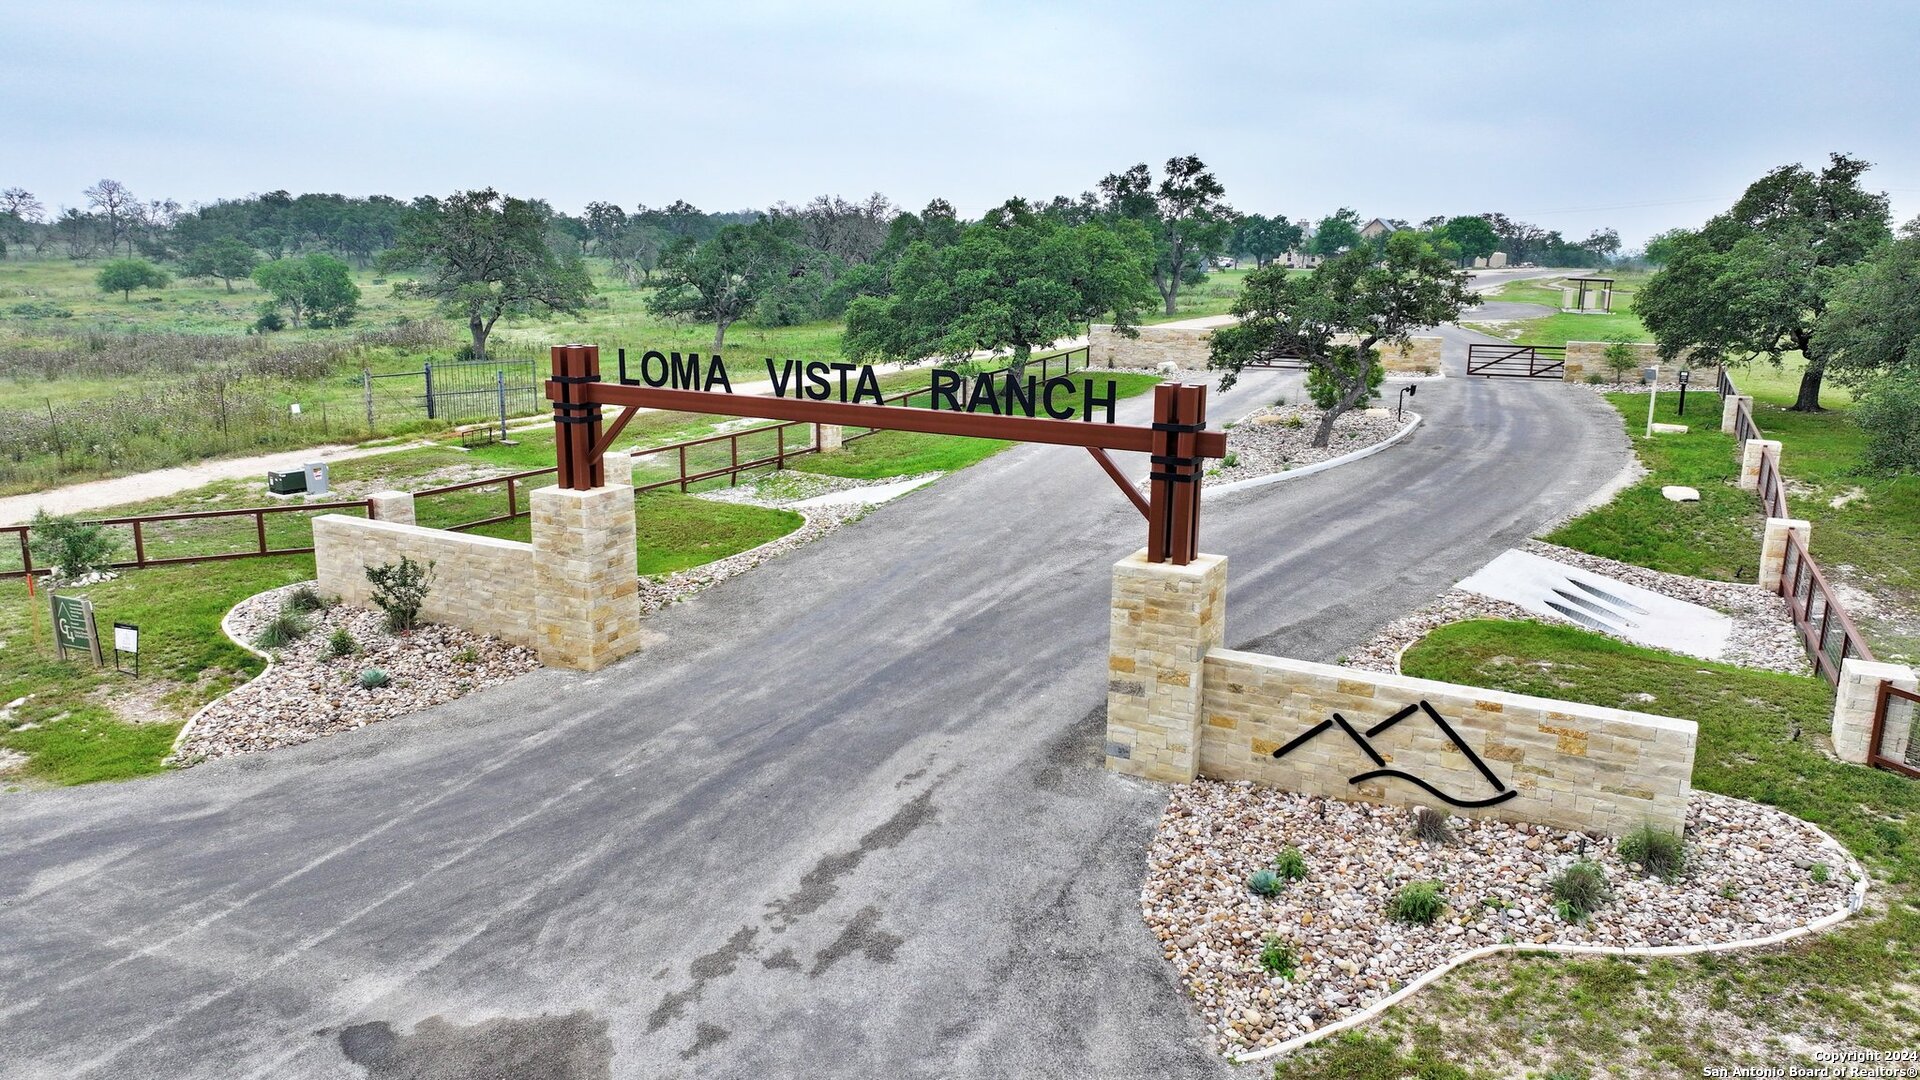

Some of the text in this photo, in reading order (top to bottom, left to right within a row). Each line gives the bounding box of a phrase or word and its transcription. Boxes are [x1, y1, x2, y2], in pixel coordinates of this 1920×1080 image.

[618, 348, 1117, 424] LOMA VISTA RANCH
